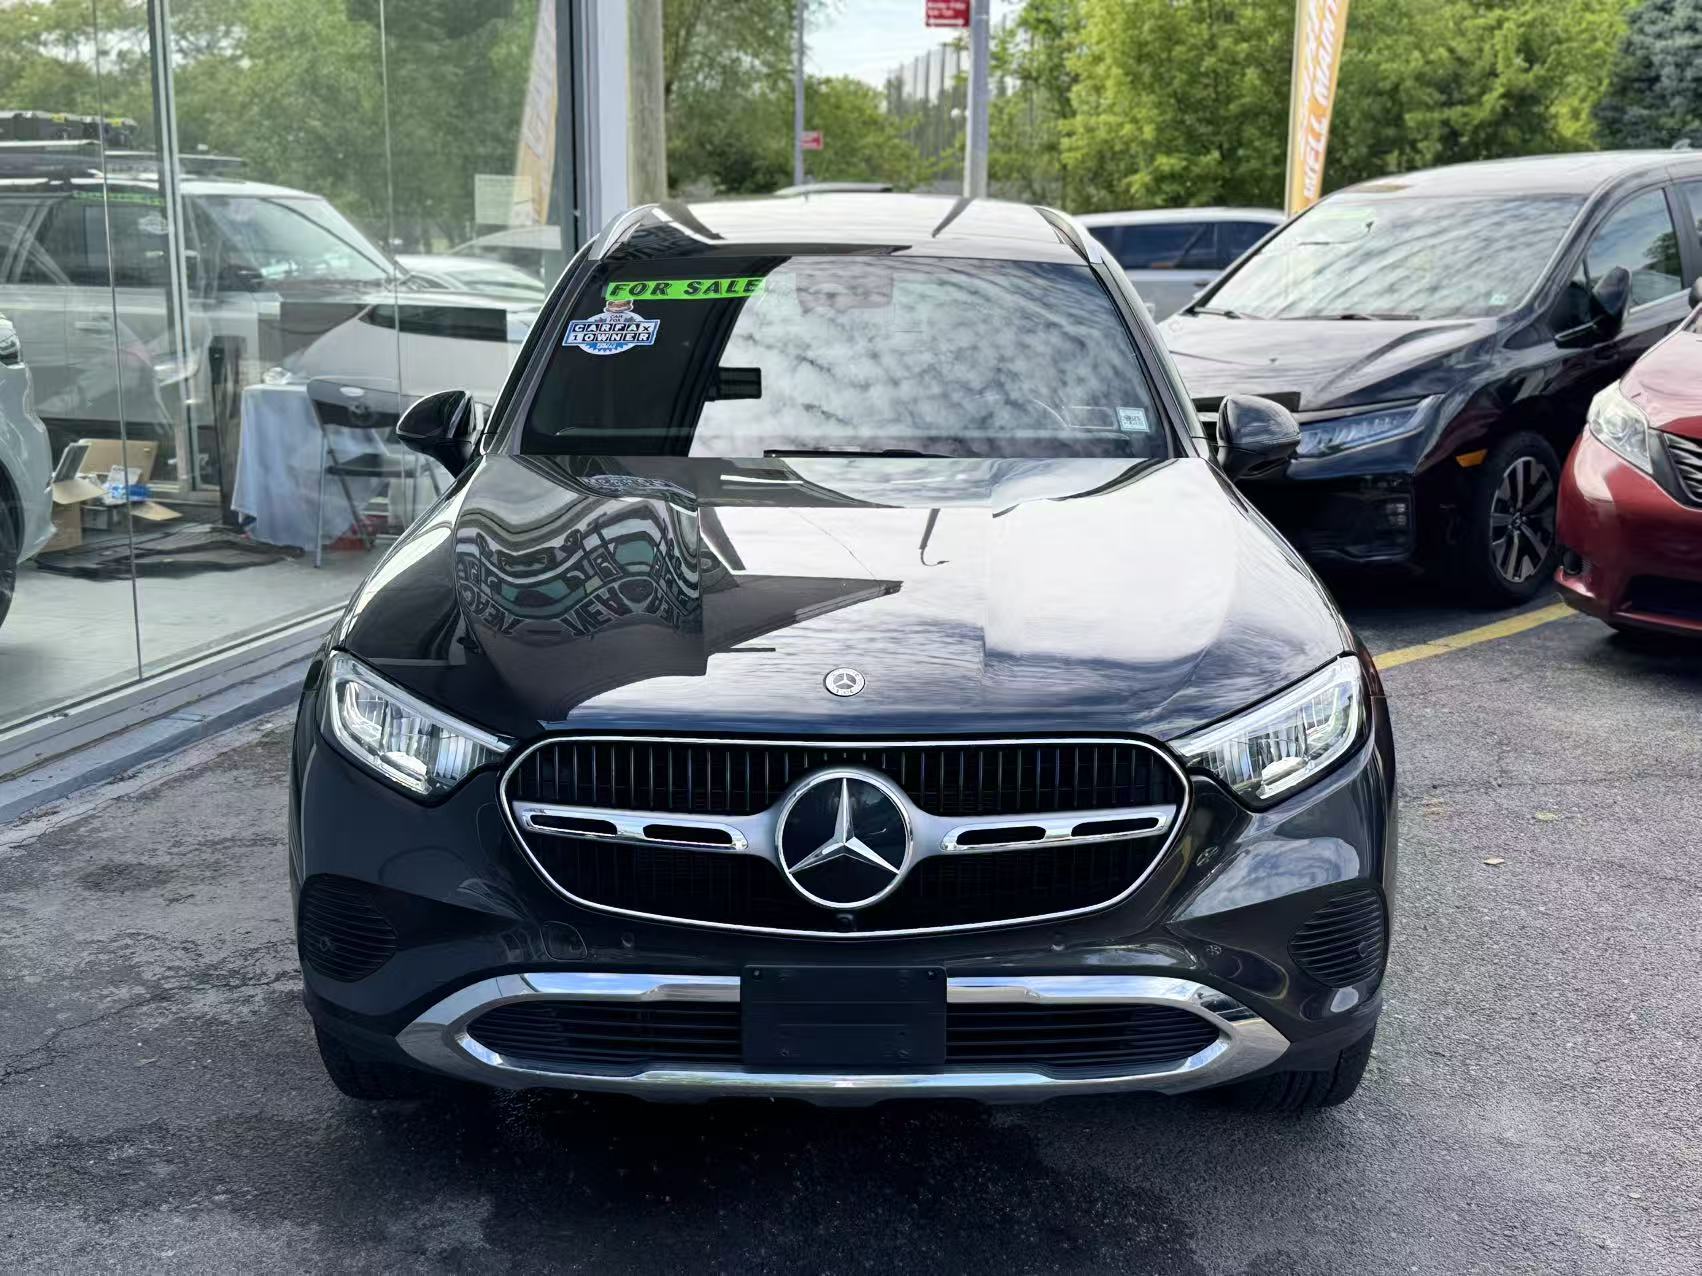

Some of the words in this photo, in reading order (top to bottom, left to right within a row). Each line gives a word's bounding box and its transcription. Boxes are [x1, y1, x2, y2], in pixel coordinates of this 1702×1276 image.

[610, 282, 672, 297] FOR
[683, 279, 762, 296] SALE
[573, 323, 652, 332] CARFAX
